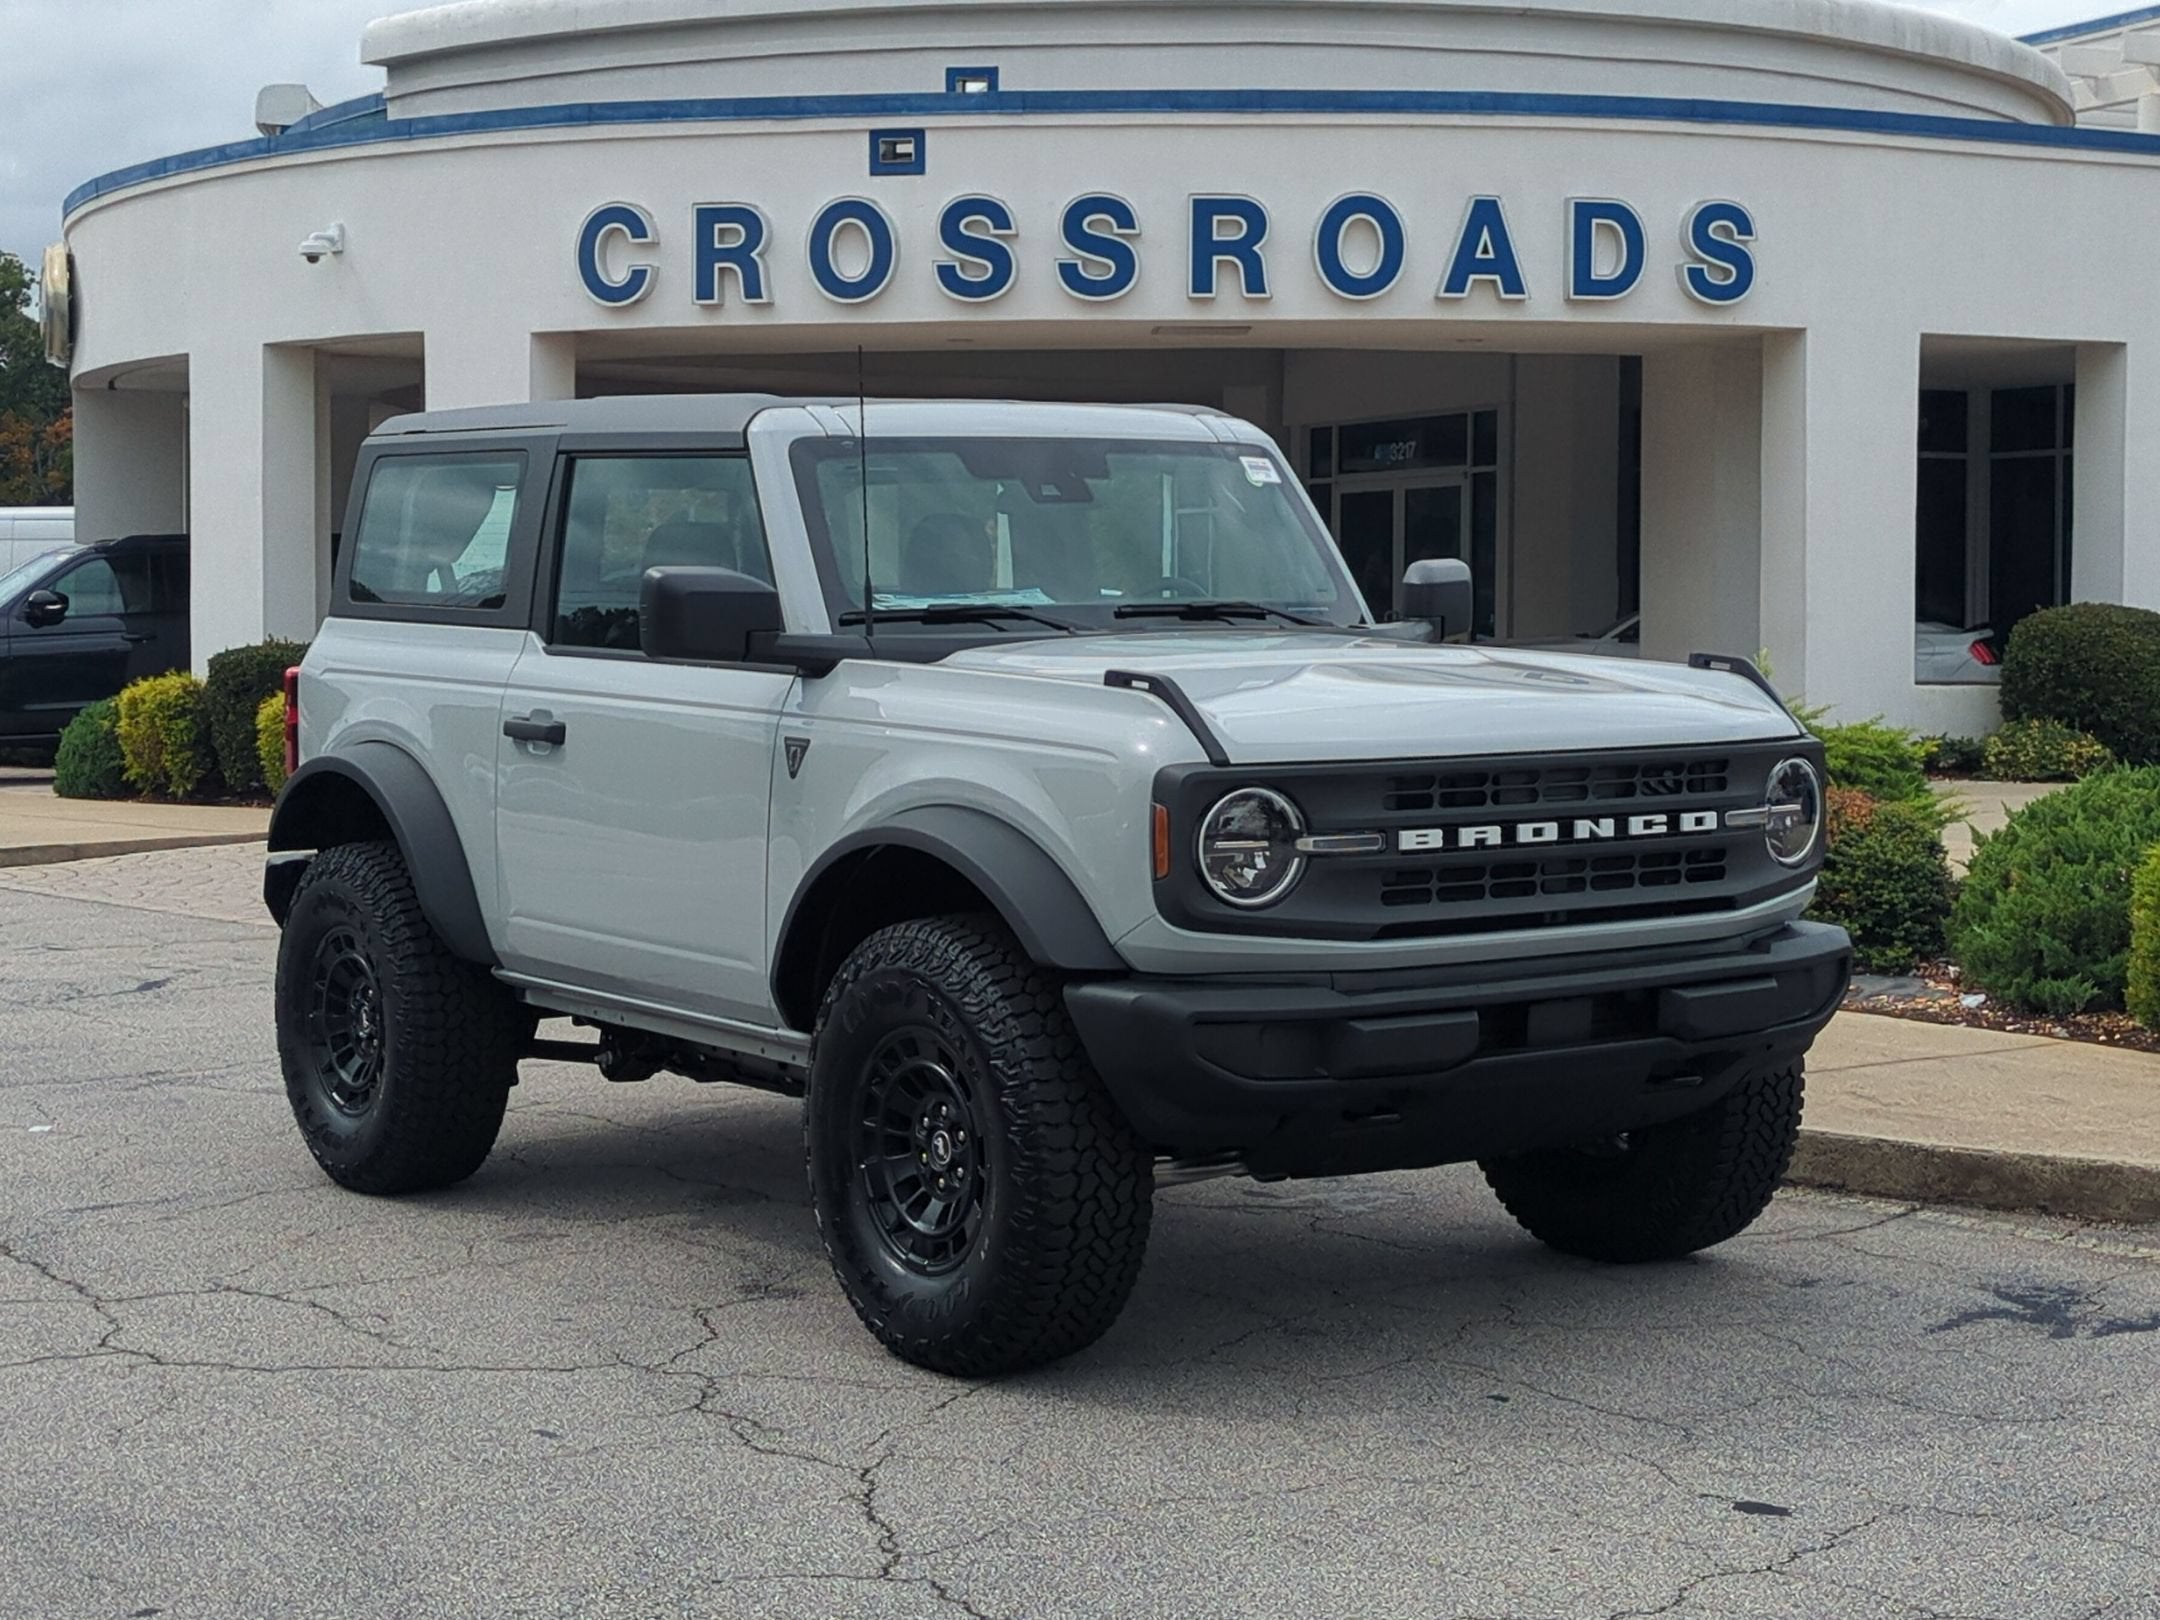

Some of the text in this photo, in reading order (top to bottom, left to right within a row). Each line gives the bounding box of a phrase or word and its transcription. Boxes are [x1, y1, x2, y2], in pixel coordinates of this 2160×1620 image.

[577, 190, 1758, 309] CROSSROADS
[1390, 440, 1417, 461] 3217
[1398, 811, 1718, 850] BRONCO
